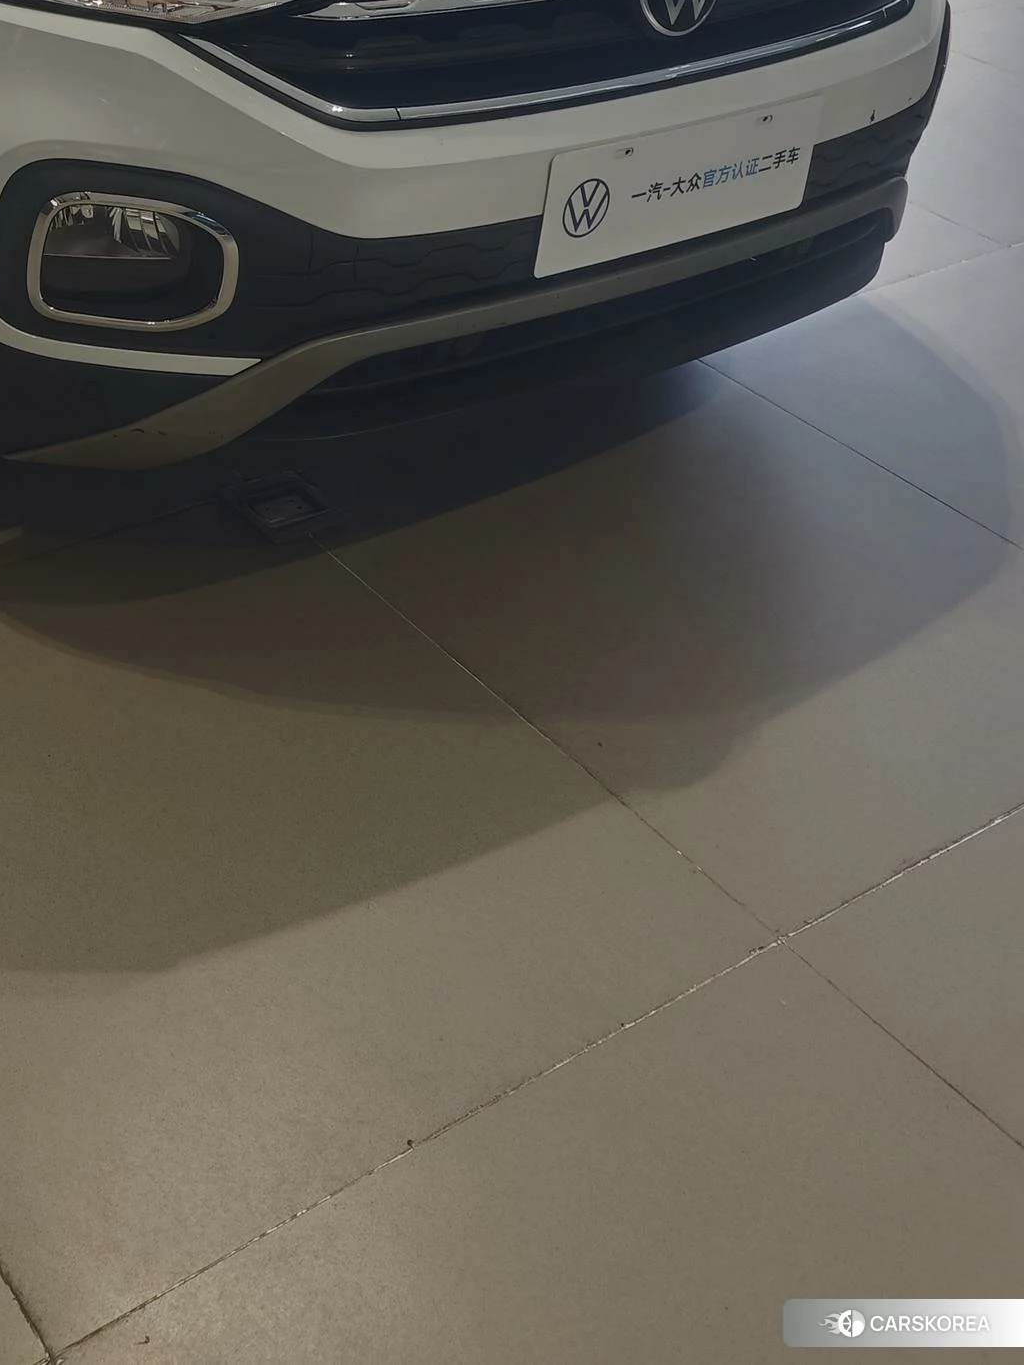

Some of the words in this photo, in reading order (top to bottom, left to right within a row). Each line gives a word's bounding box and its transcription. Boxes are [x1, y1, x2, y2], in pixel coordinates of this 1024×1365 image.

[631, 146, 801, 202] 一汽-大众官方认证二手车
[562, 178, 610, 238] VW
